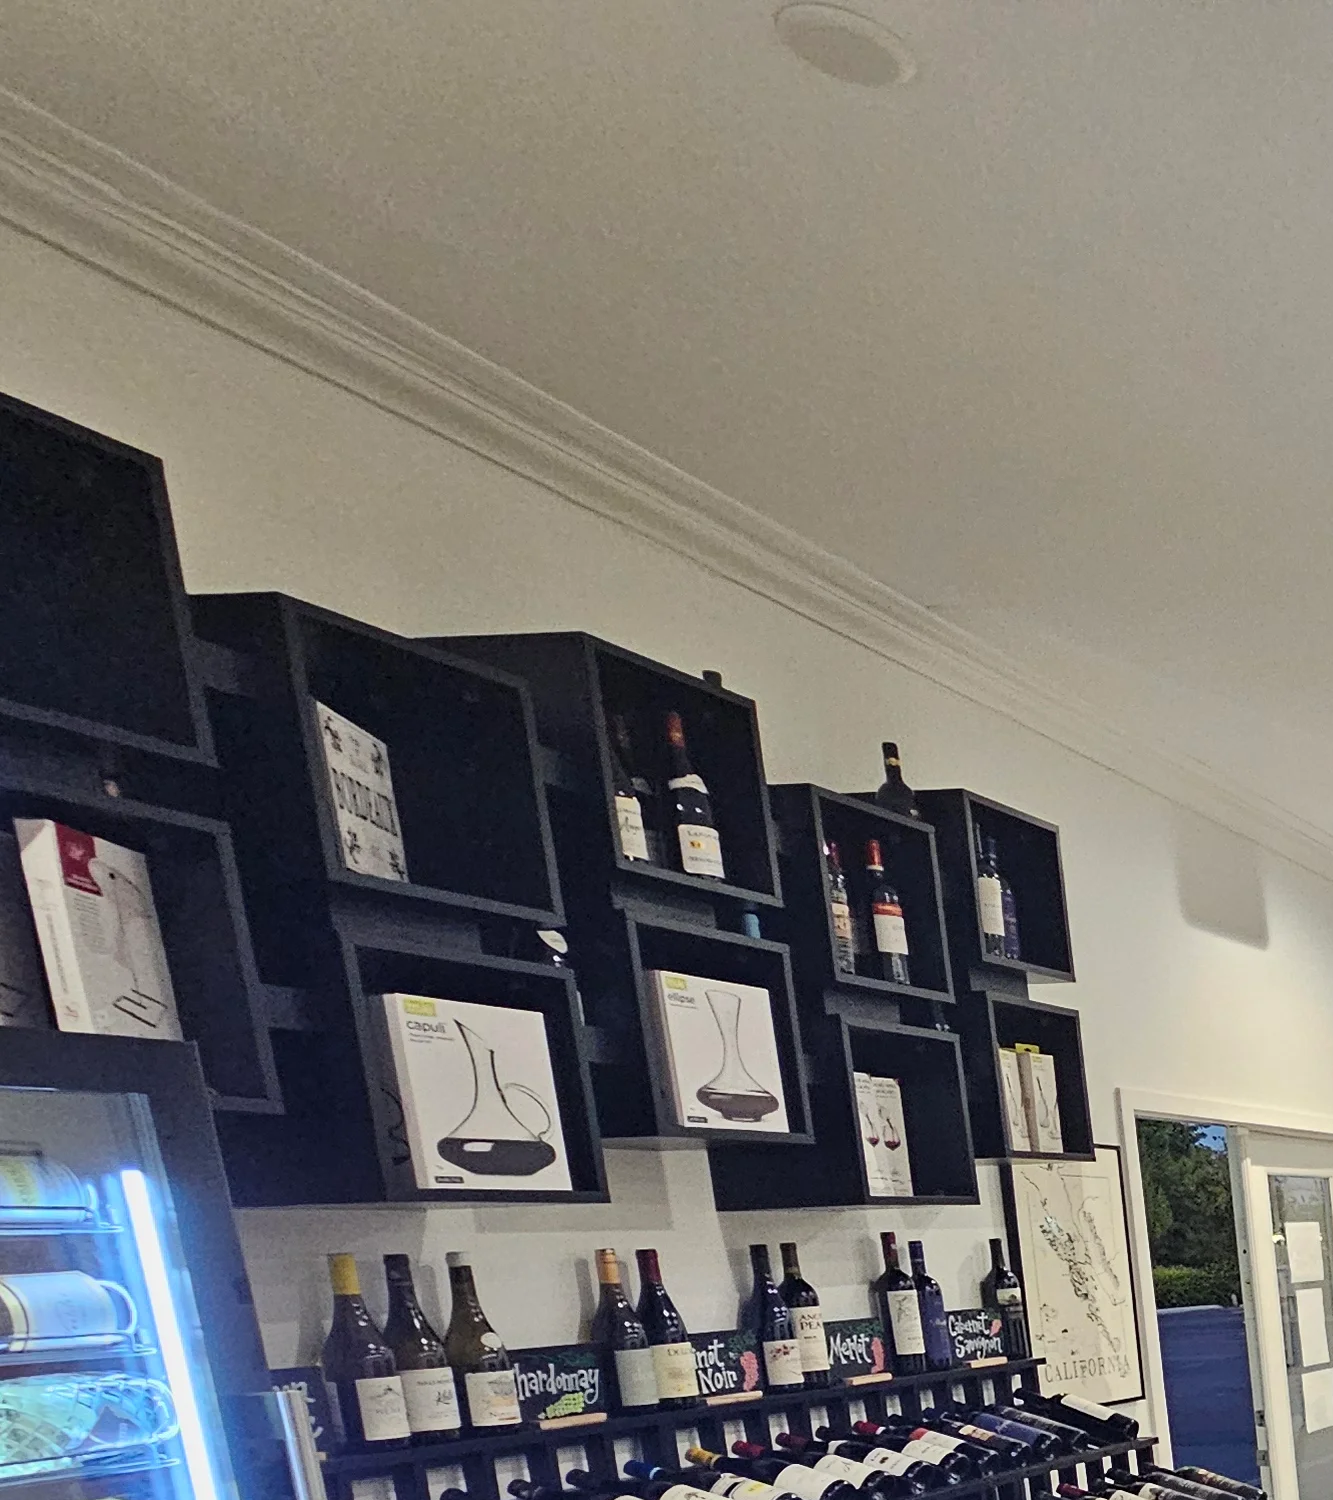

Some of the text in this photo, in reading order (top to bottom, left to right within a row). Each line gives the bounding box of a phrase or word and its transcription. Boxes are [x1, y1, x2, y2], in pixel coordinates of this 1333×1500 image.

[829, 1333, 872, 1365] Merlot
[513, 1362, 600, 1404] hardonnay
[699, 1368, 738, 1394] Noir
[1044, 1352, 1133, 1385] CALIFORNIA
